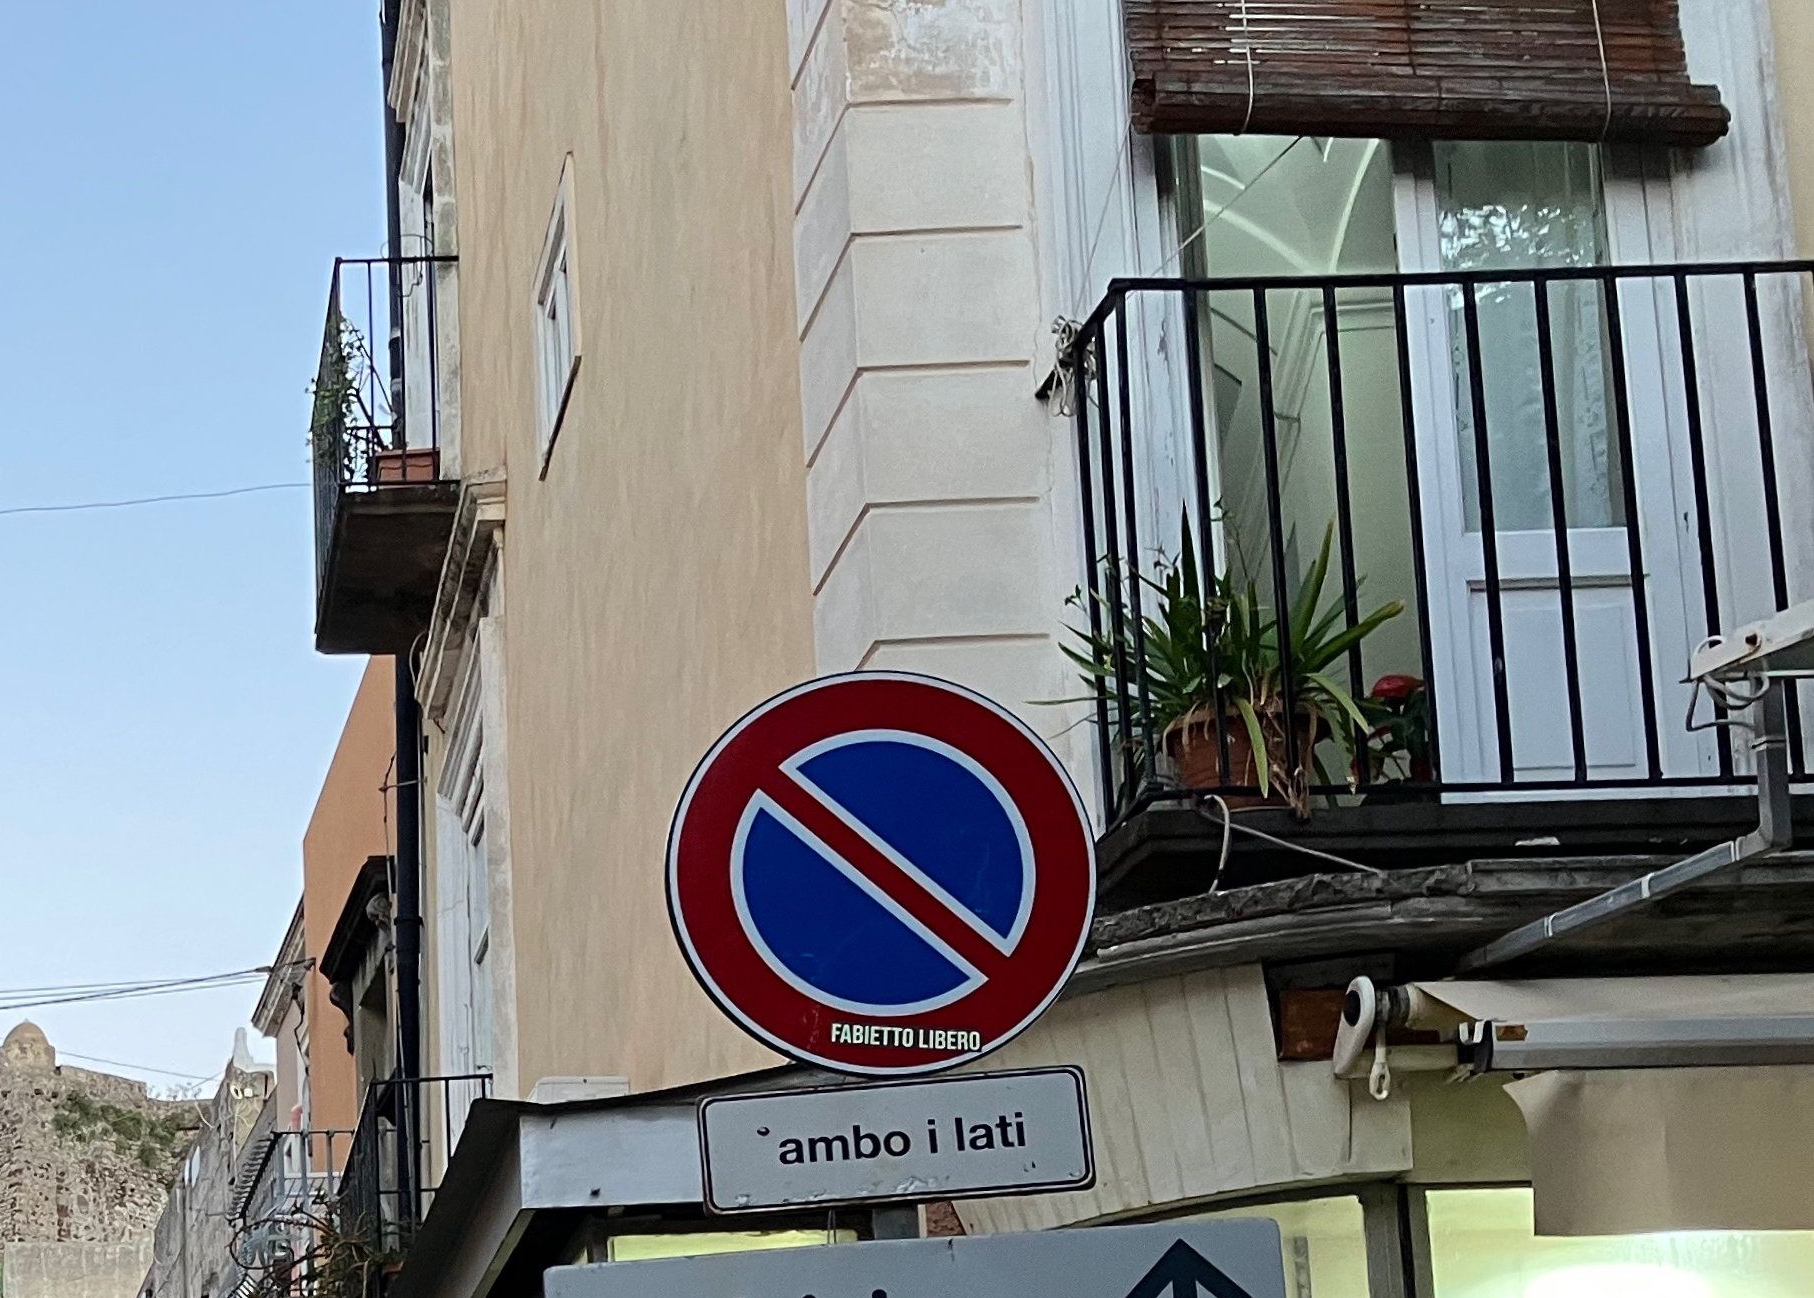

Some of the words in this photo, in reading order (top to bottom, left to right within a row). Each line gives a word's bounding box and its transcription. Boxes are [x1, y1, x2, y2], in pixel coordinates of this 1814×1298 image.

[831, 1023, 914, 1047] FABIETTO
[918, 1029, 981, 1050] LIBERO
[779, 1125, 911, 1165] ambo
[927, 1118, 939, 1154] i
[954, 1111, 1026, 1152] lati
